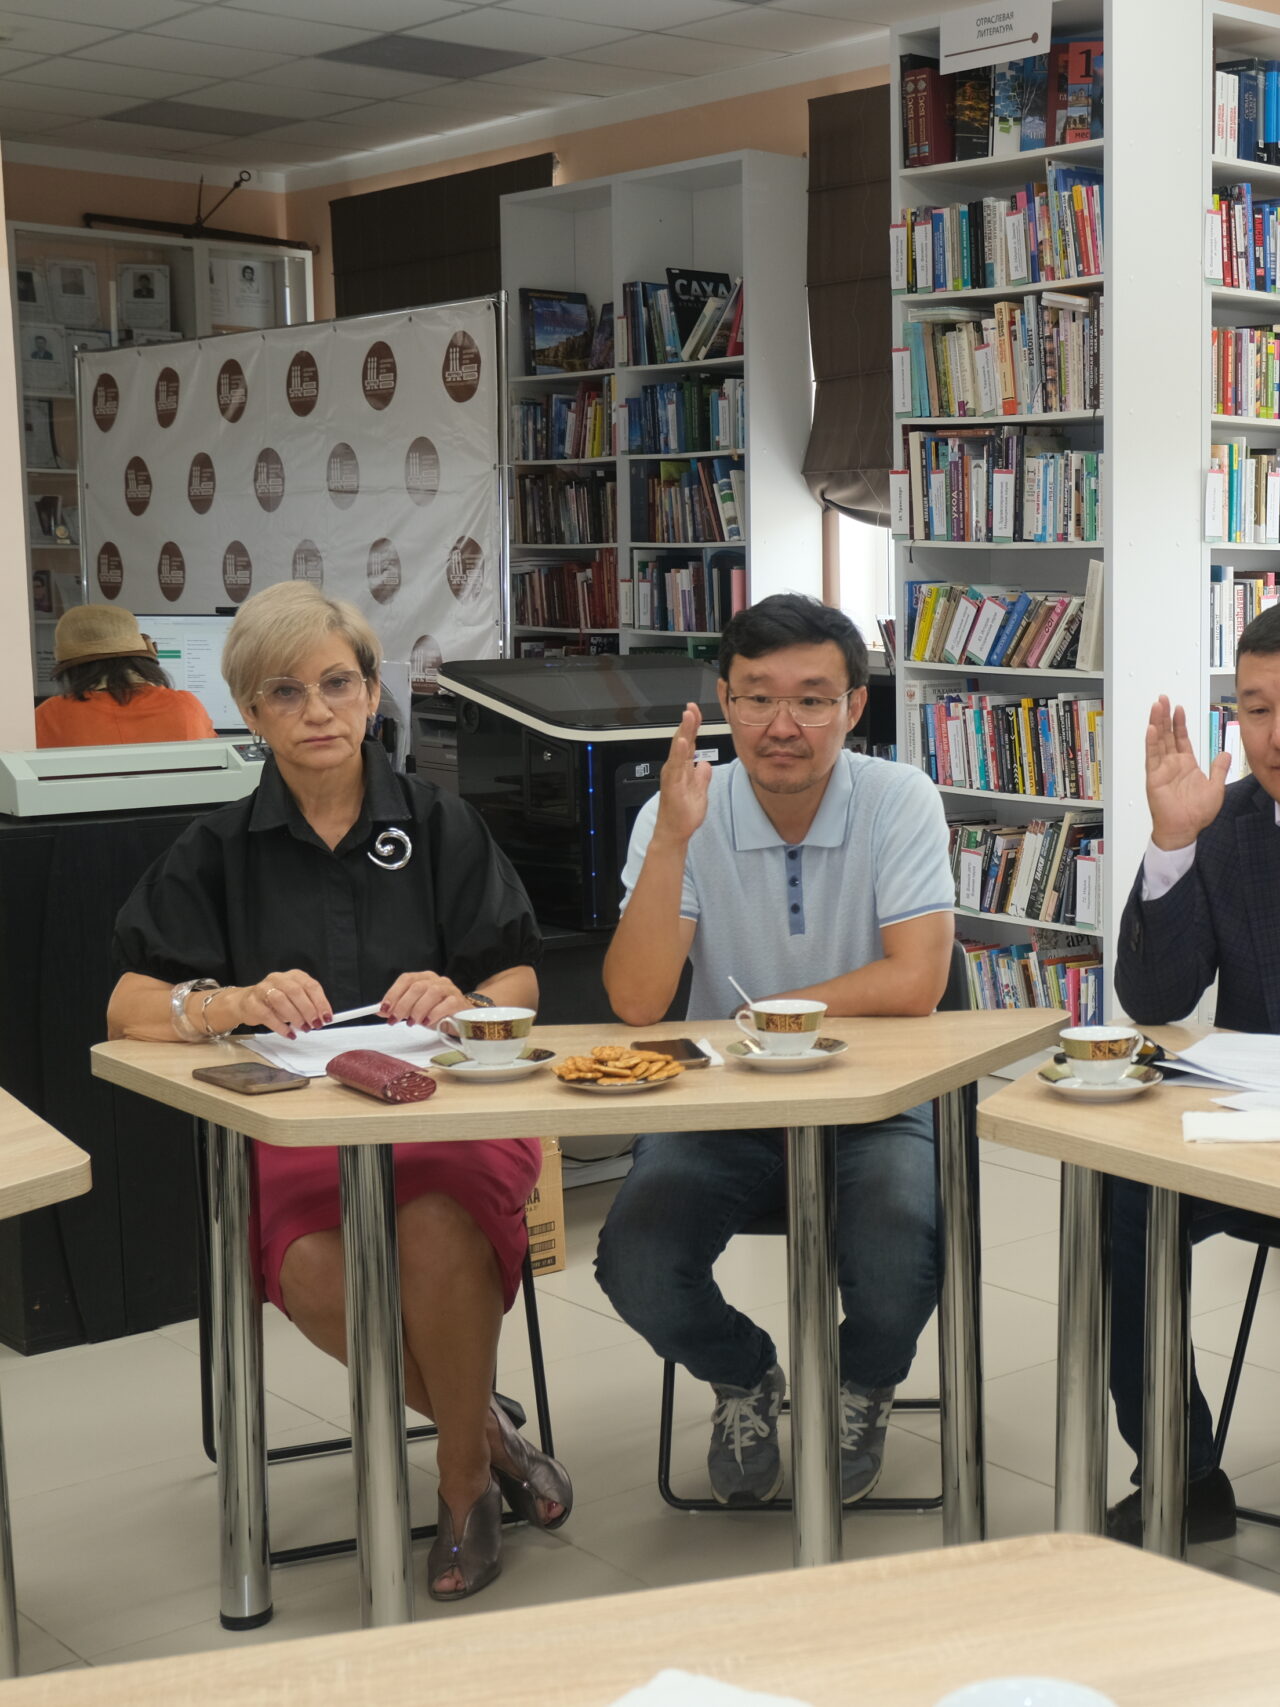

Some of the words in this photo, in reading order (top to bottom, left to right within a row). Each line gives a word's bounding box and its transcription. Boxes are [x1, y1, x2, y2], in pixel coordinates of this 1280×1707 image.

[976, 11, 1014, 27] ОТРАСЛЕВАЯ
[977, 24, 1013, 39] ЛИТЕРАТУРА
[1034, 860, 1045, 882] ТАНКИ
